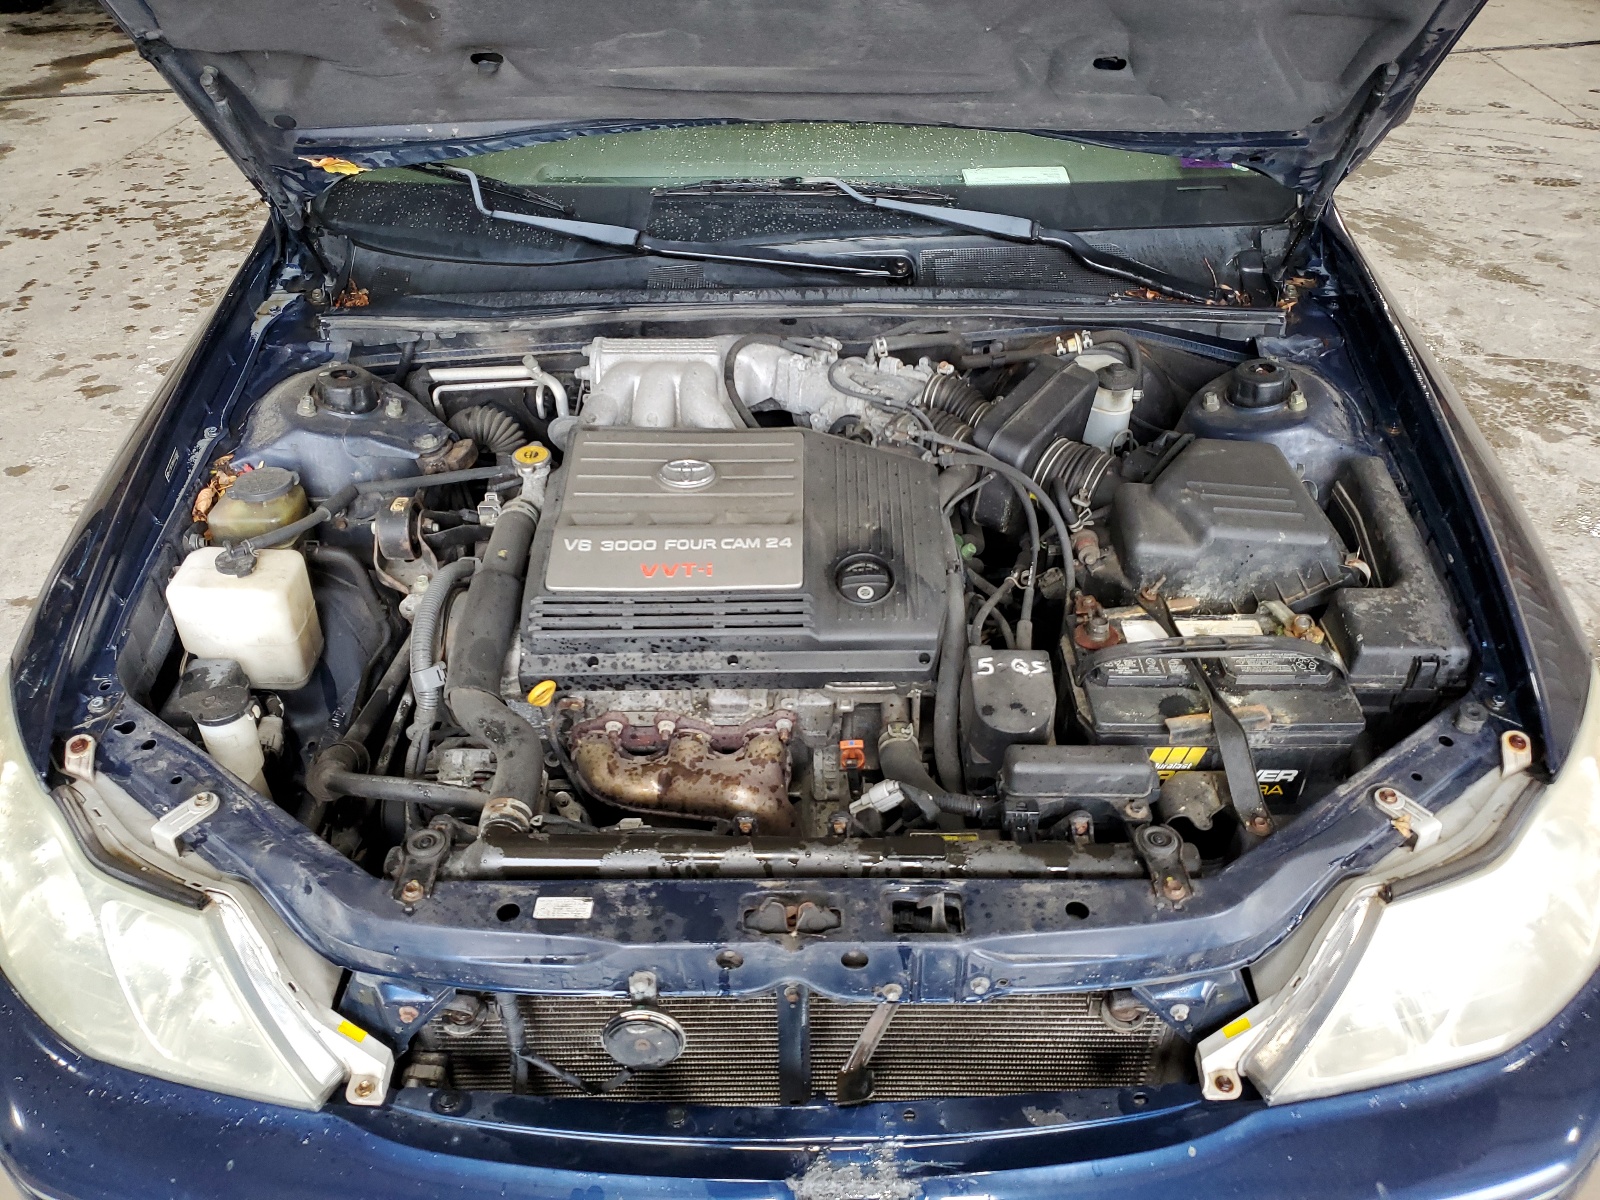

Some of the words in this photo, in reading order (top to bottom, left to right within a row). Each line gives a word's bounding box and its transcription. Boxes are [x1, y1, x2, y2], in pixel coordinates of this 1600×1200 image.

[563, 538, 592, 551] V6
[600, 539, 657, 551] 3000
[664, 539, 717, 550] FOUR
[721, 538, 761, 549] CAM
[765, 537, 793, 548] 24
[640, 562, 714, 578] VVT-i
